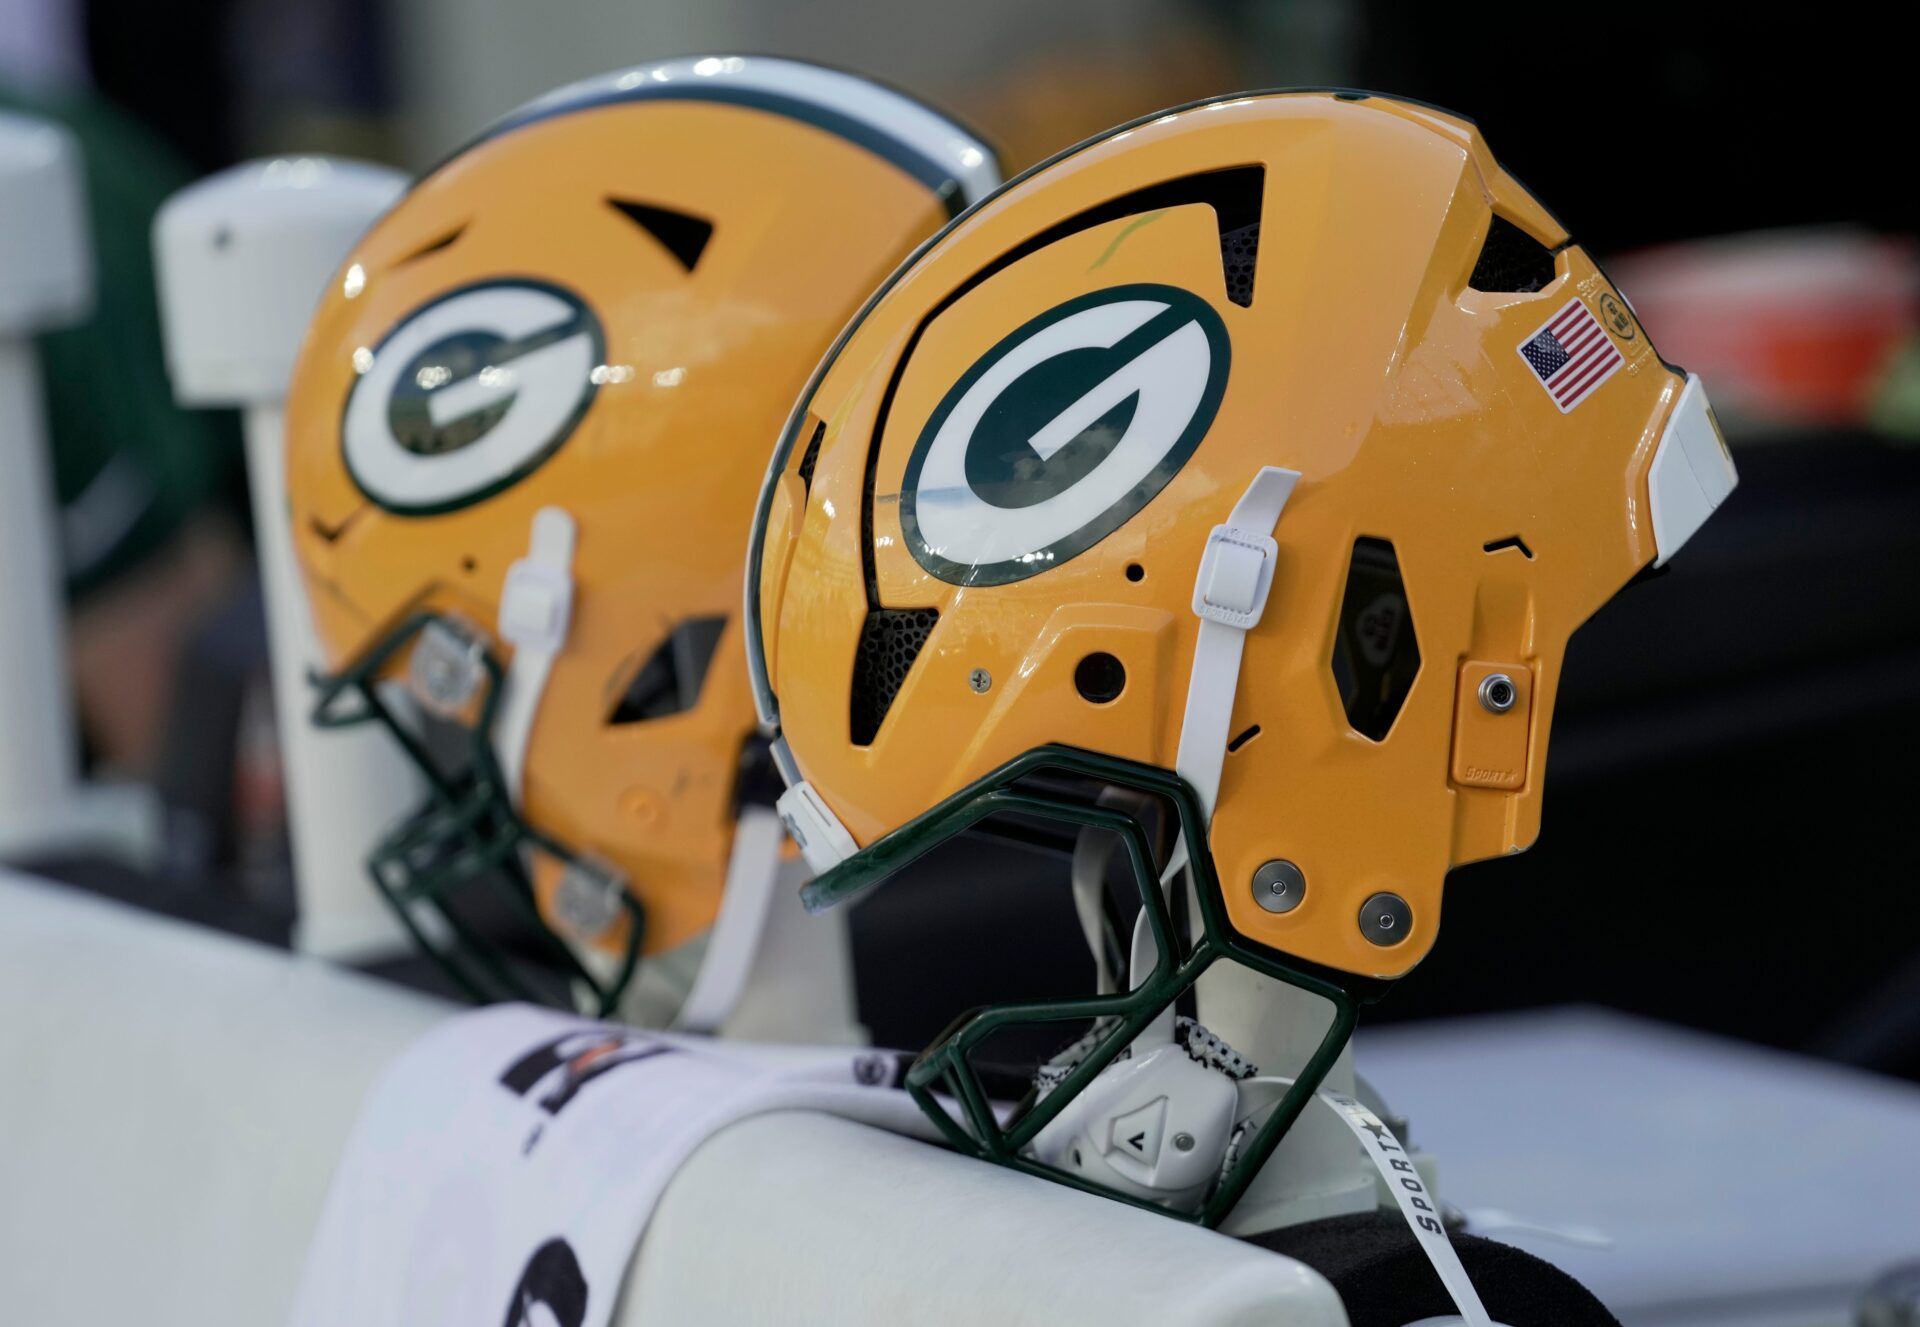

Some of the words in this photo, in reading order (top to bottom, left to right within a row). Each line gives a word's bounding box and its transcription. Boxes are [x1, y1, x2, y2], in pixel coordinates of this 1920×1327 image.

[344, 287, 592, 506] G
[916, 300, 1211, 566] G
[1378, 1142, 1442, 1235] SPORT
